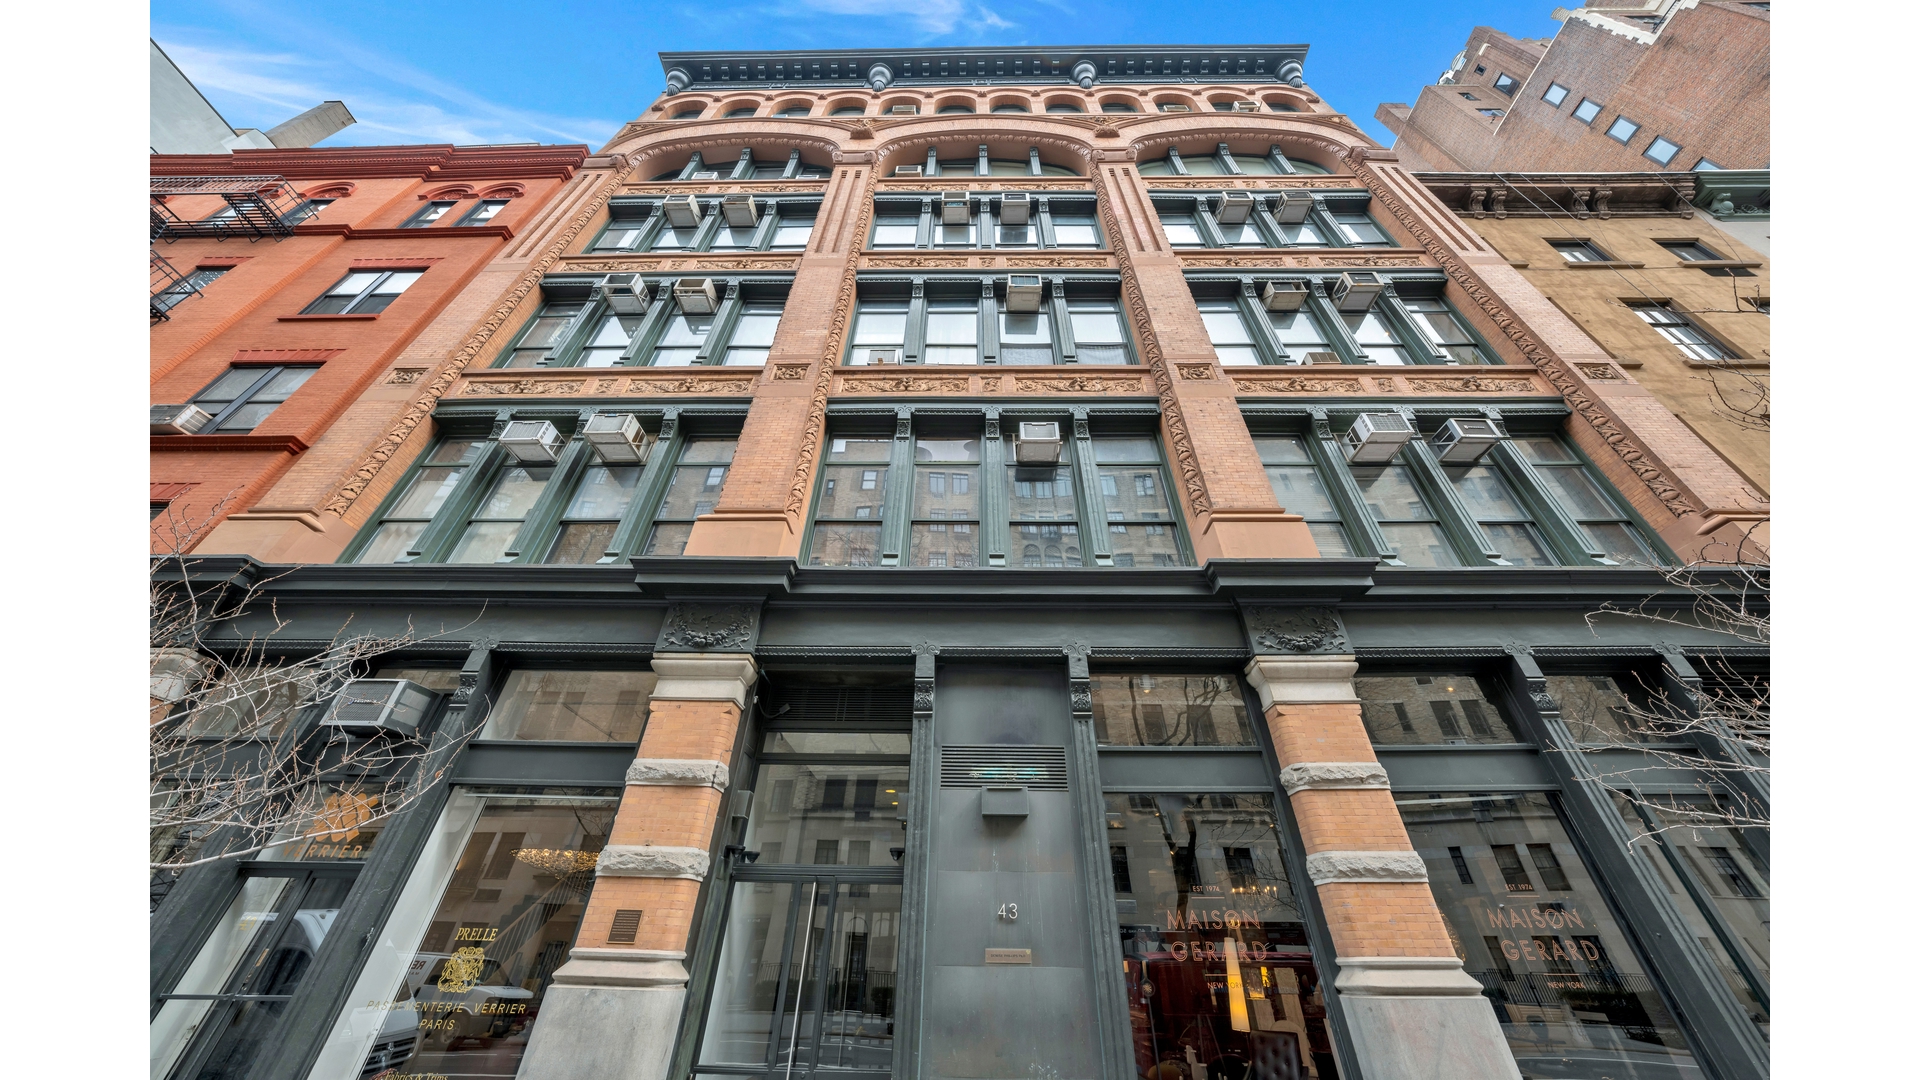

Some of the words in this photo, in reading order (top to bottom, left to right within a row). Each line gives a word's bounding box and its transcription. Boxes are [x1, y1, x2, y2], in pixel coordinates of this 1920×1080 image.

[283, 844, 363, 858] VERRIER
[998, 903, 1018, 919] 43
[1486, 908, 1585, 929] MAISON
[1167, 910, 1261, 929] MAISON
[454, 927, 499, 941] PRELLE
[1171, 941, 1267, 962] GERARD
[1500, 939, 1600, 961] GERARD
[365, 1000, 465, 1013] PASSEMENTERIE
[474, 1003, 526, 1014] VERRIER
[418, 1019, 456, 1030] PARIS
